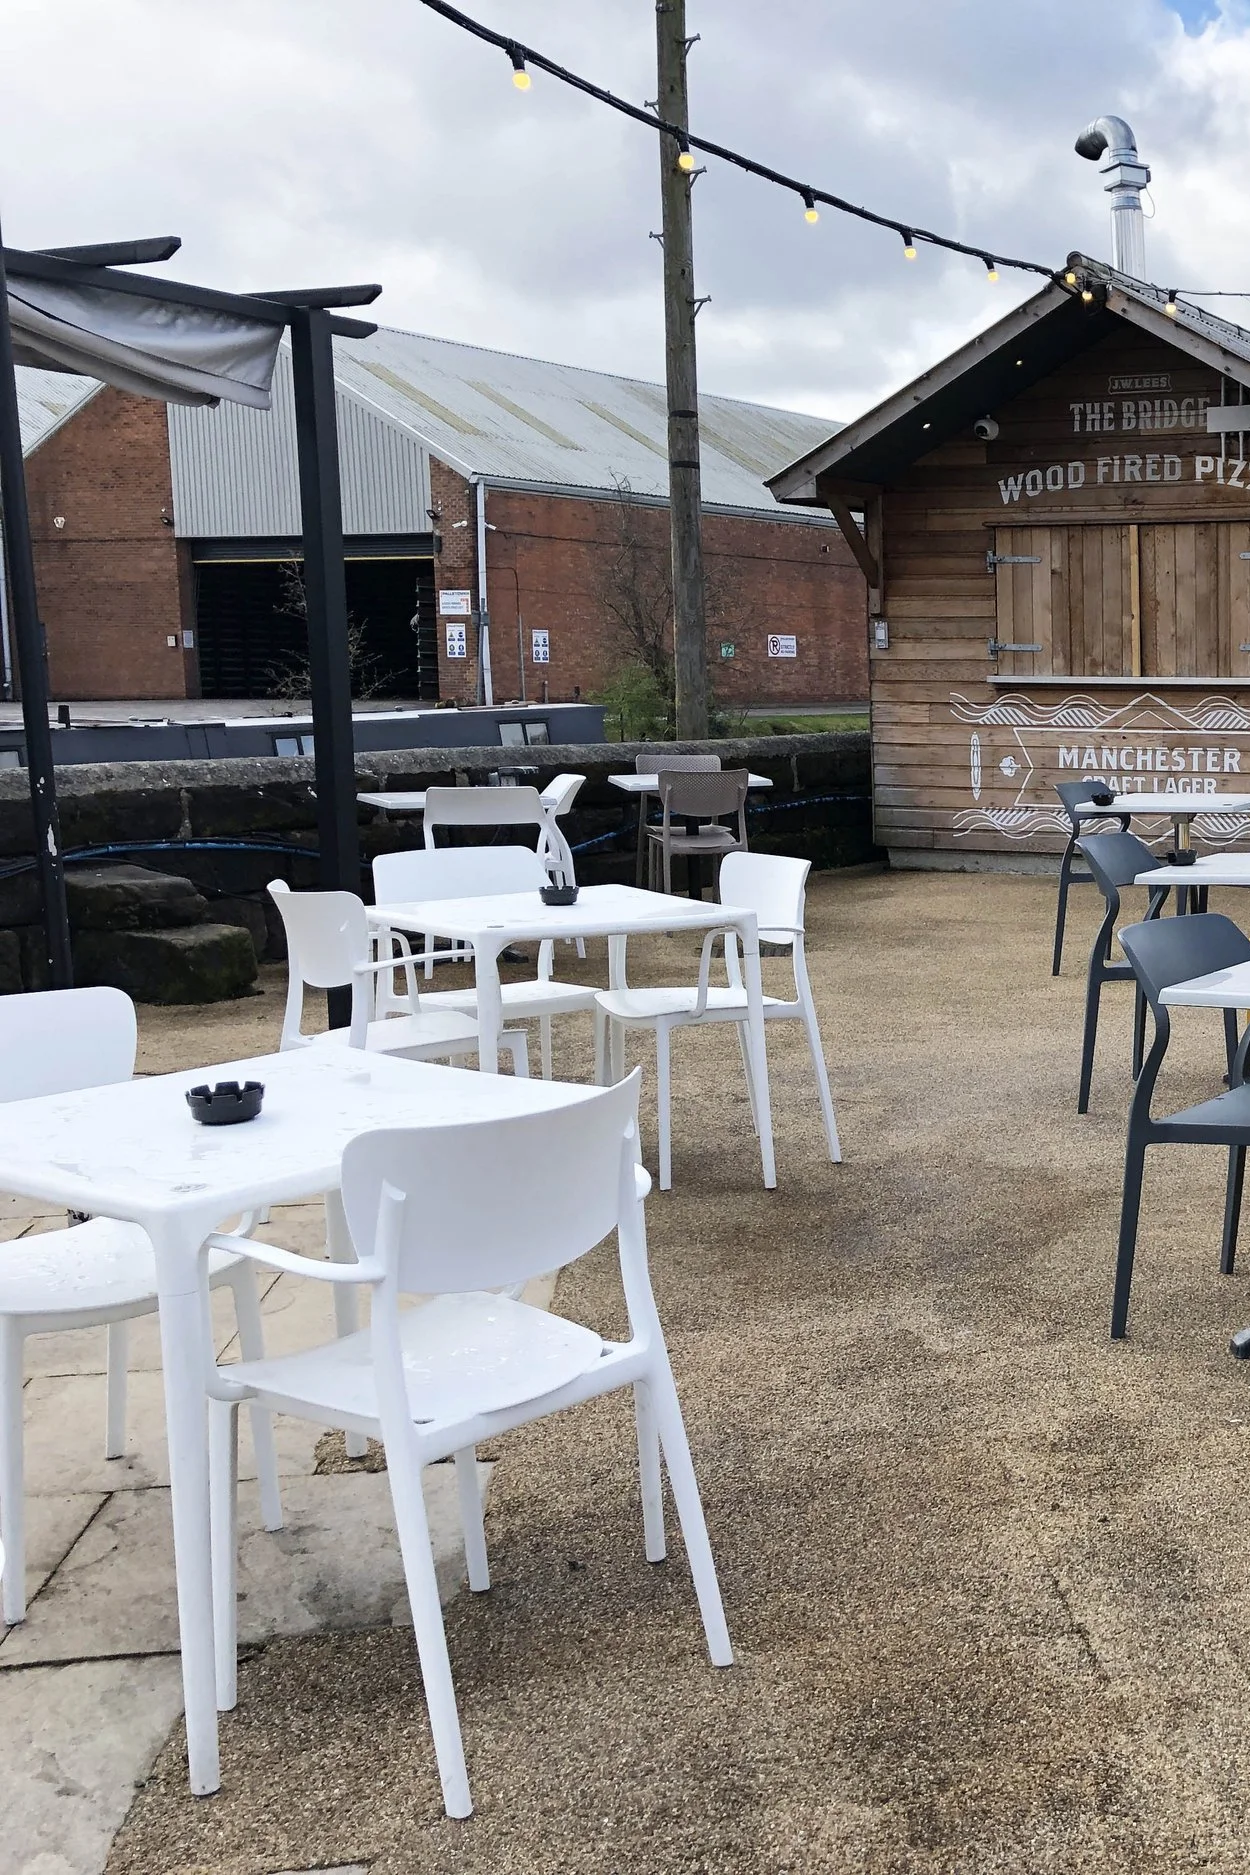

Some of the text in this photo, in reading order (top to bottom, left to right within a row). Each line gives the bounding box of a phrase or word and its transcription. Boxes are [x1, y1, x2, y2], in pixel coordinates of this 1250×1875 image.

[1070, 402, 1115, 432] THE
[998, 461, 1085, 505] WOOD
[1097, 454, 1182, 484] FIRED
[1058, 745, 1241, 773] MANCHESTER
[1153, 777, 1217, 795] LAGER
